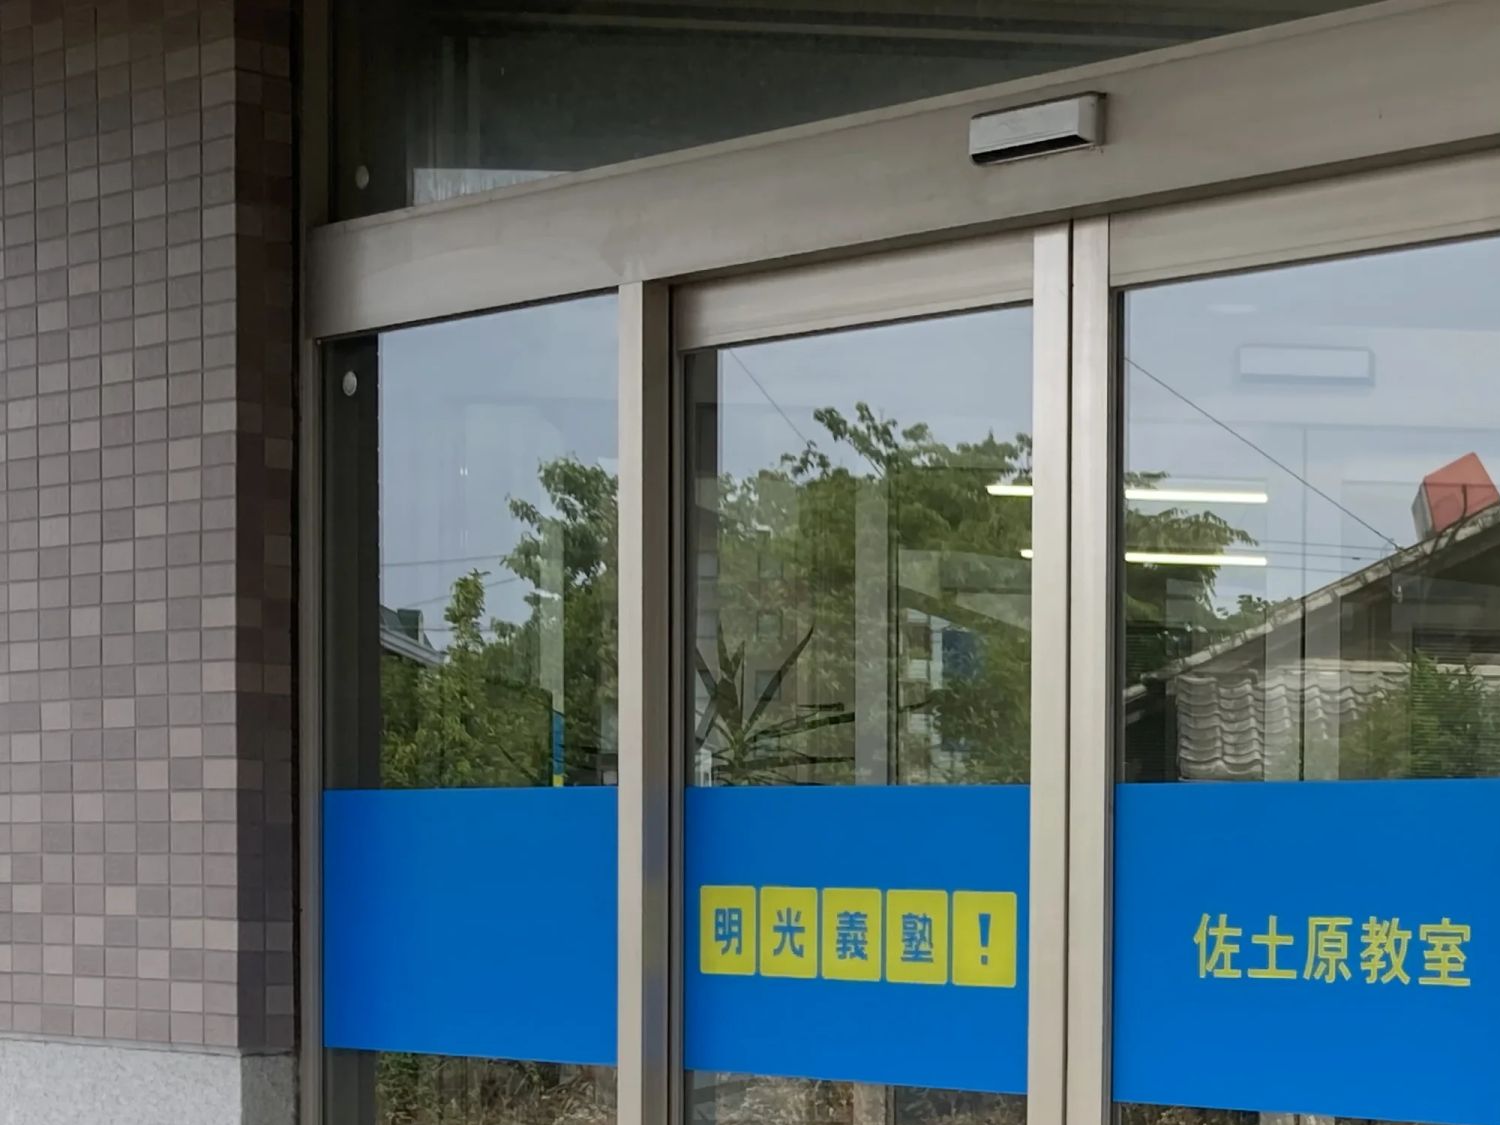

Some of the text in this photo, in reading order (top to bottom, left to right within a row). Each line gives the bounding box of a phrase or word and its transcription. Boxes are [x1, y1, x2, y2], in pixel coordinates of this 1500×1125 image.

[1193, 912, 1472, 987] 佐土原教室
